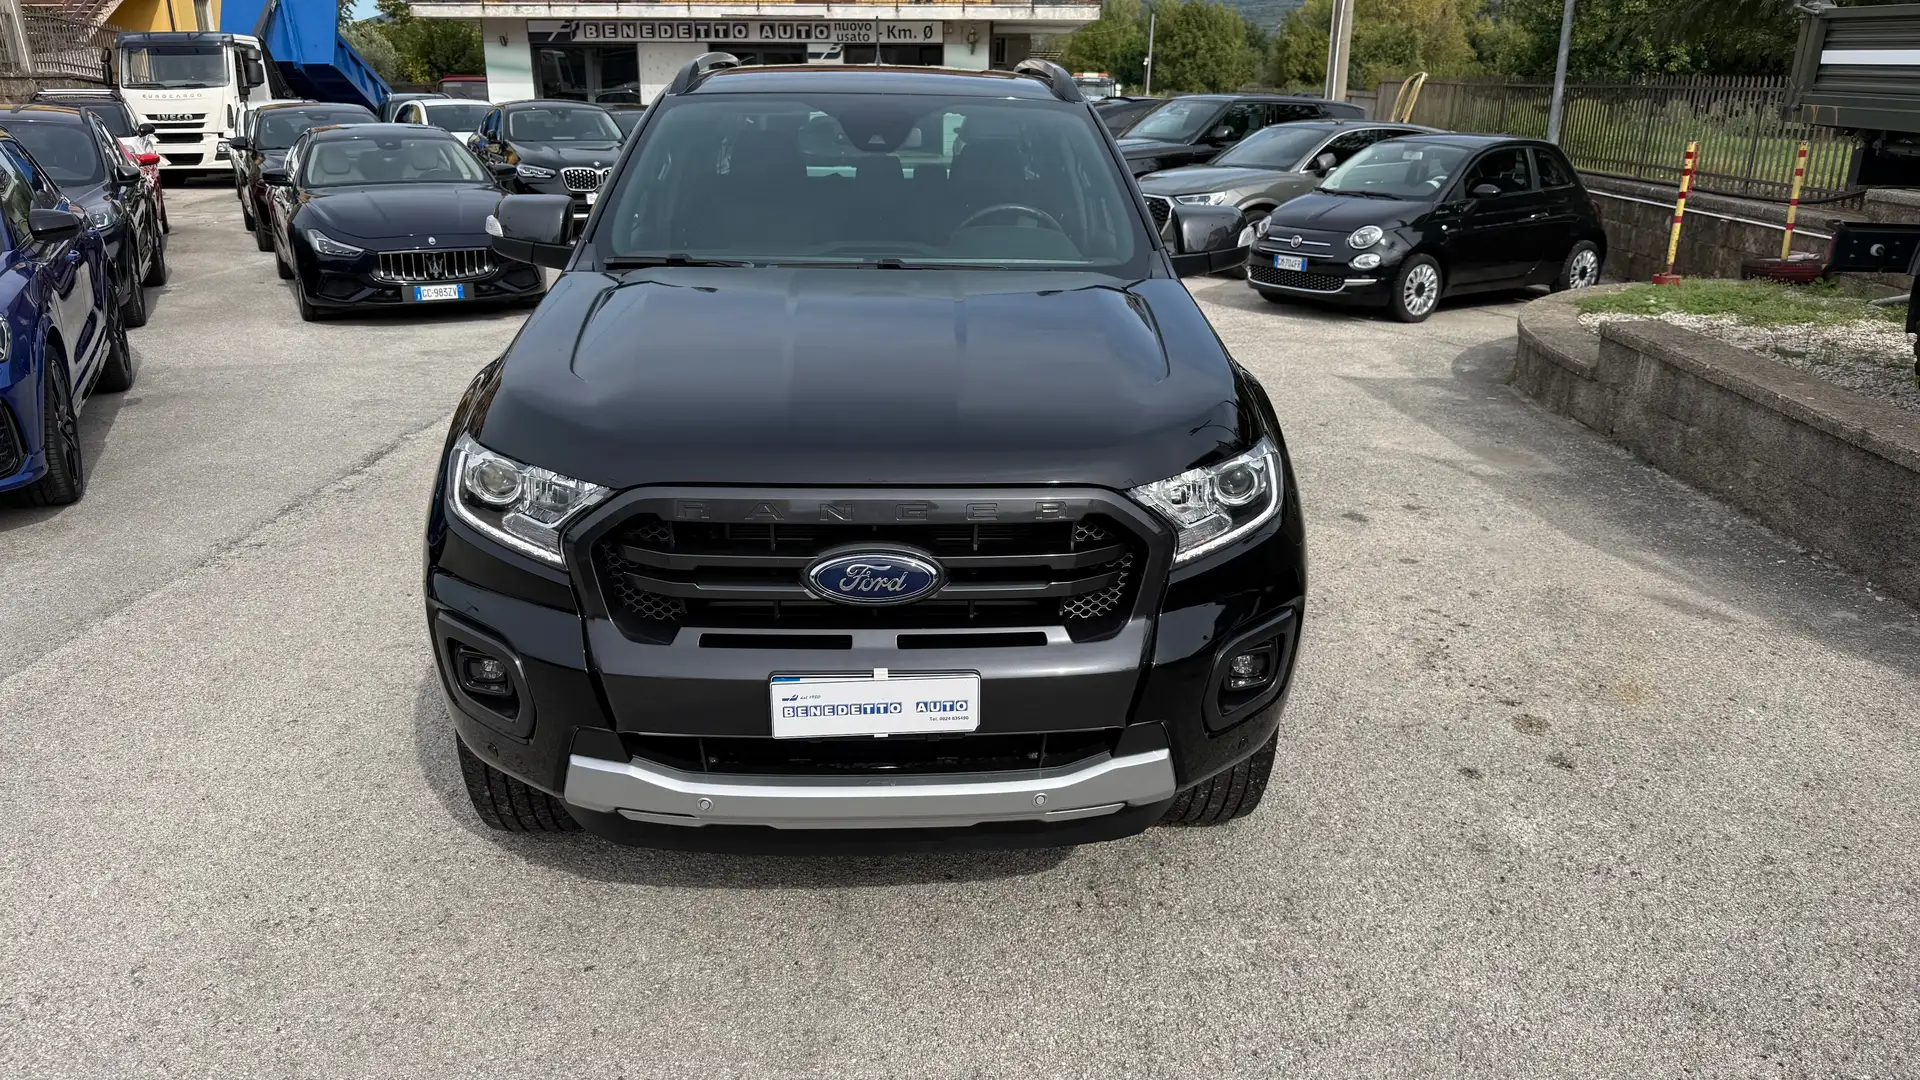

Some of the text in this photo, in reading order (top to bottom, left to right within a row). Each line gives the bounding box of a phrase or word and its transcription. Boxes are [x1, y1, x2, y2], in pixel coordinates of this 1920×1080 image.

[585, 23, 830, 39] BENEDETTO AUTO
[834, 22, 872, 32] nuovo
[887, 25, 917, 39] Km.
[836, 31, 870, 42] usato
[156, 113, 193, 121] IVECO
[676, 500, 1068, 521] RANGER
[839, 563, 908, 593] Ford
[783, 700, 968, 718] BENEDETTO AUTO
